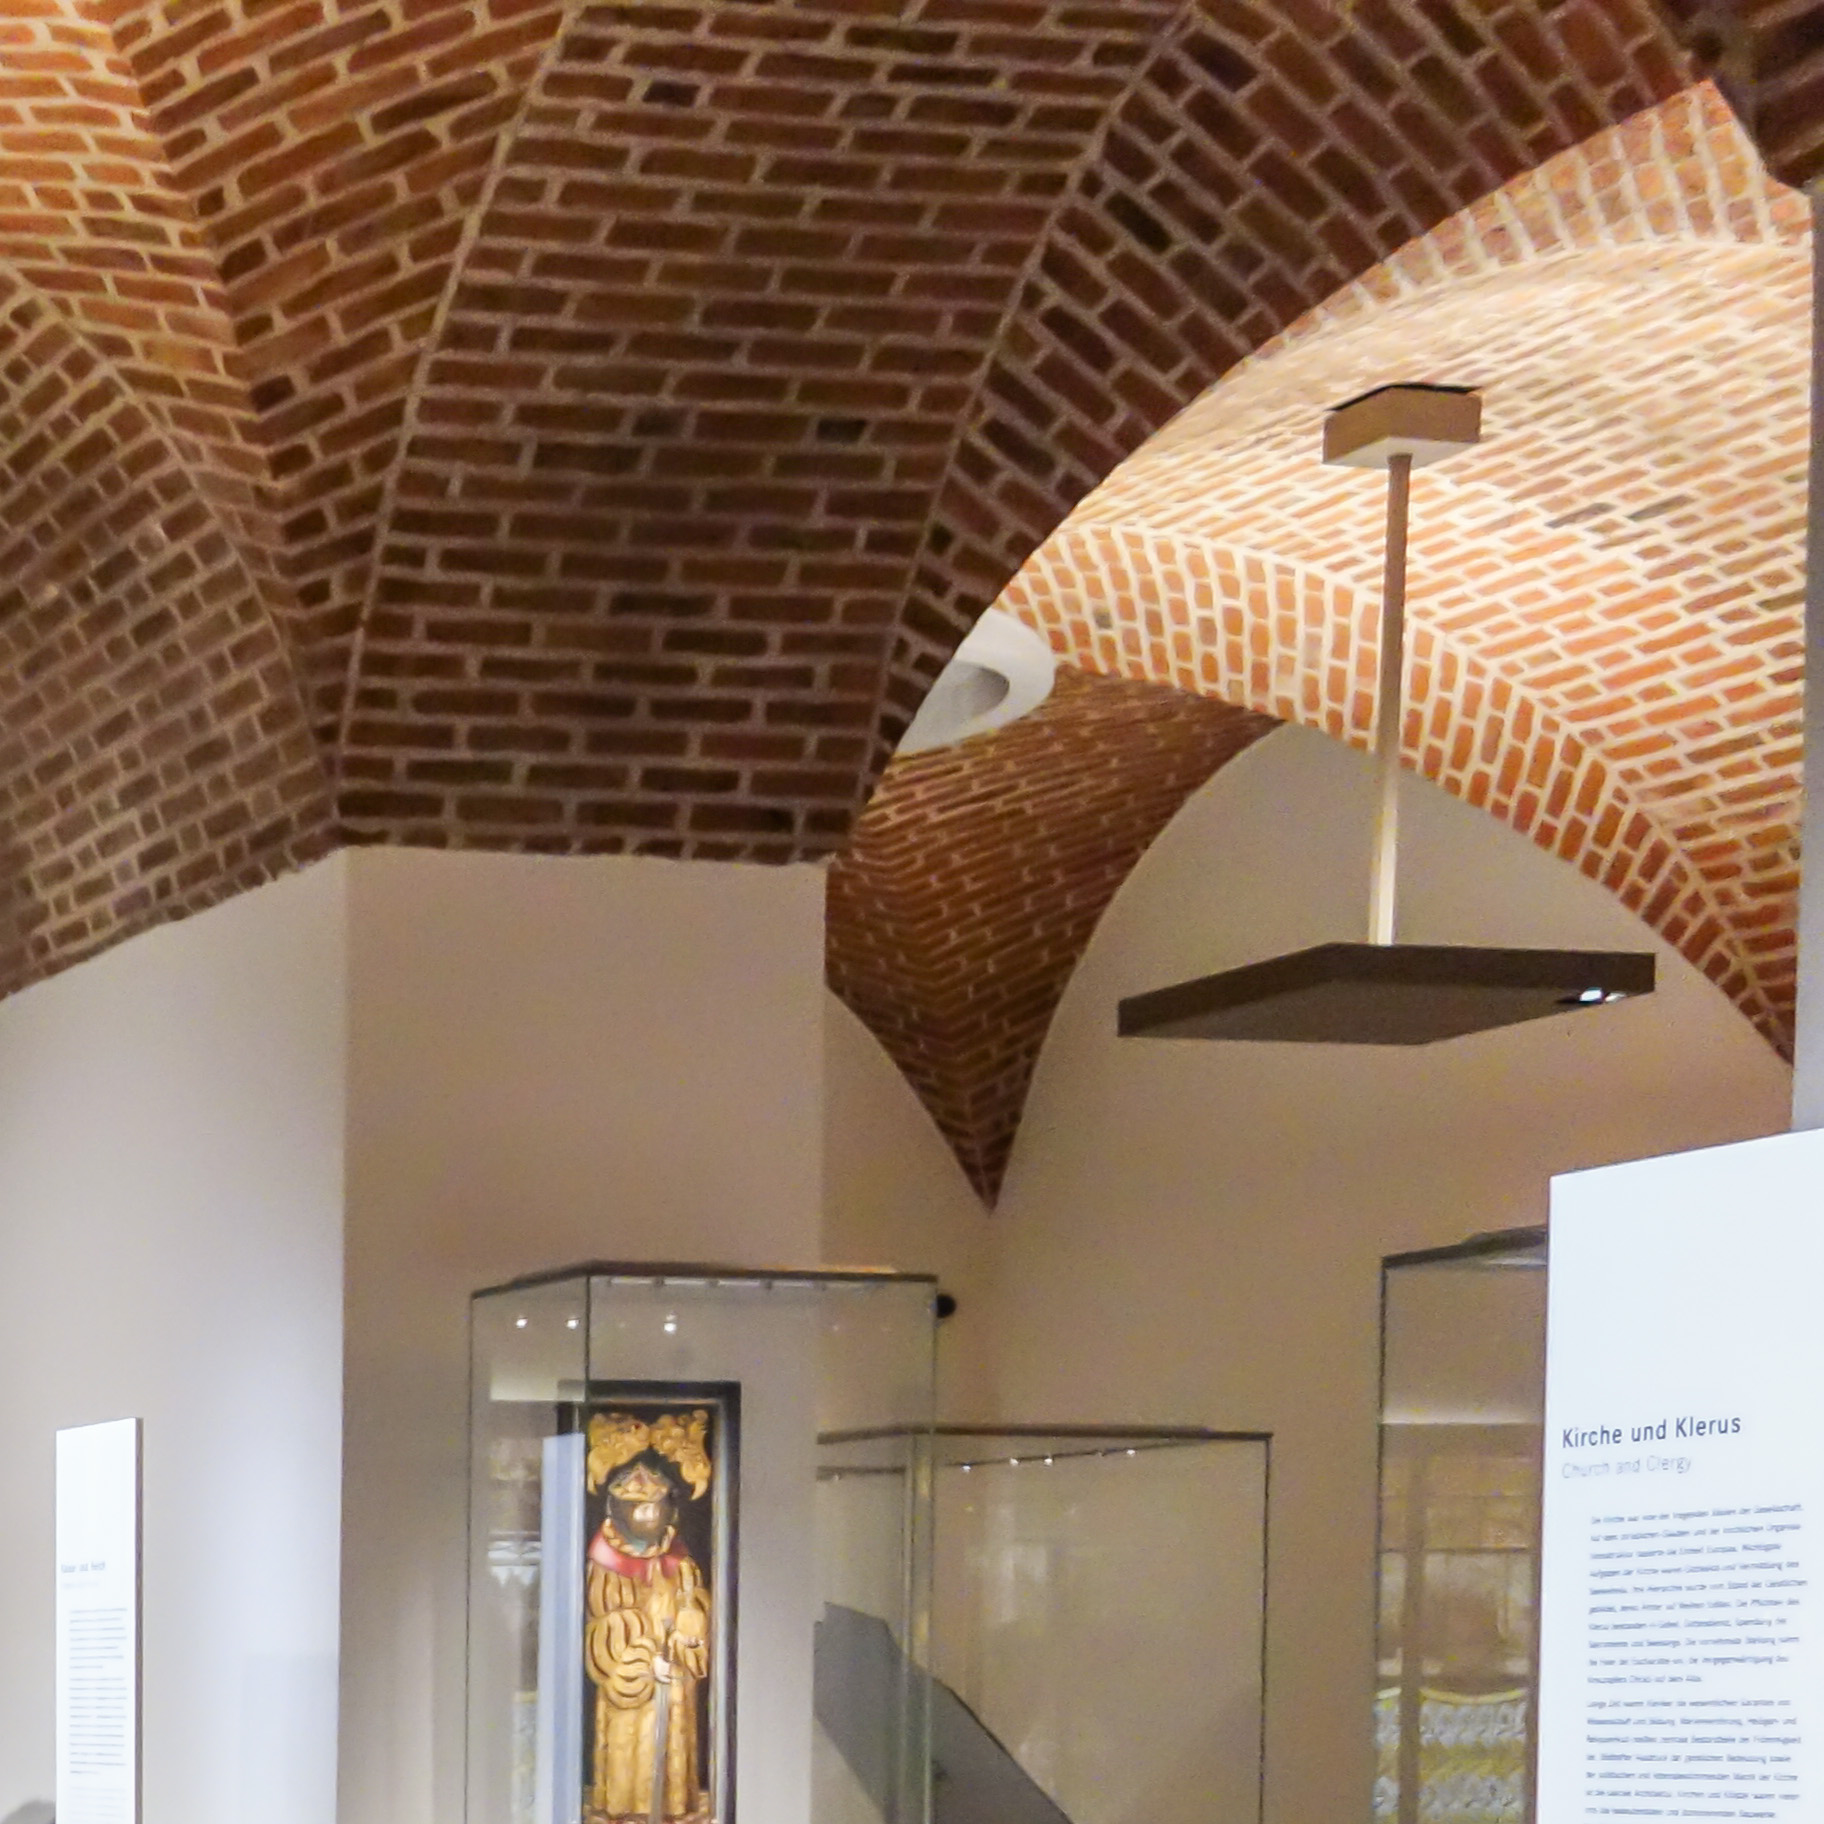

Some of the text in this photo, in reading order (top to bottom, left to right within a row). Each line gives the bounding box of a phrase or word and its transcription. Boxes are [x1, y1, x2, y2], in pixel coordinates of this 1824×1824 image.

[1562, 1416, 1741, 1448] Kirche und Klerus
